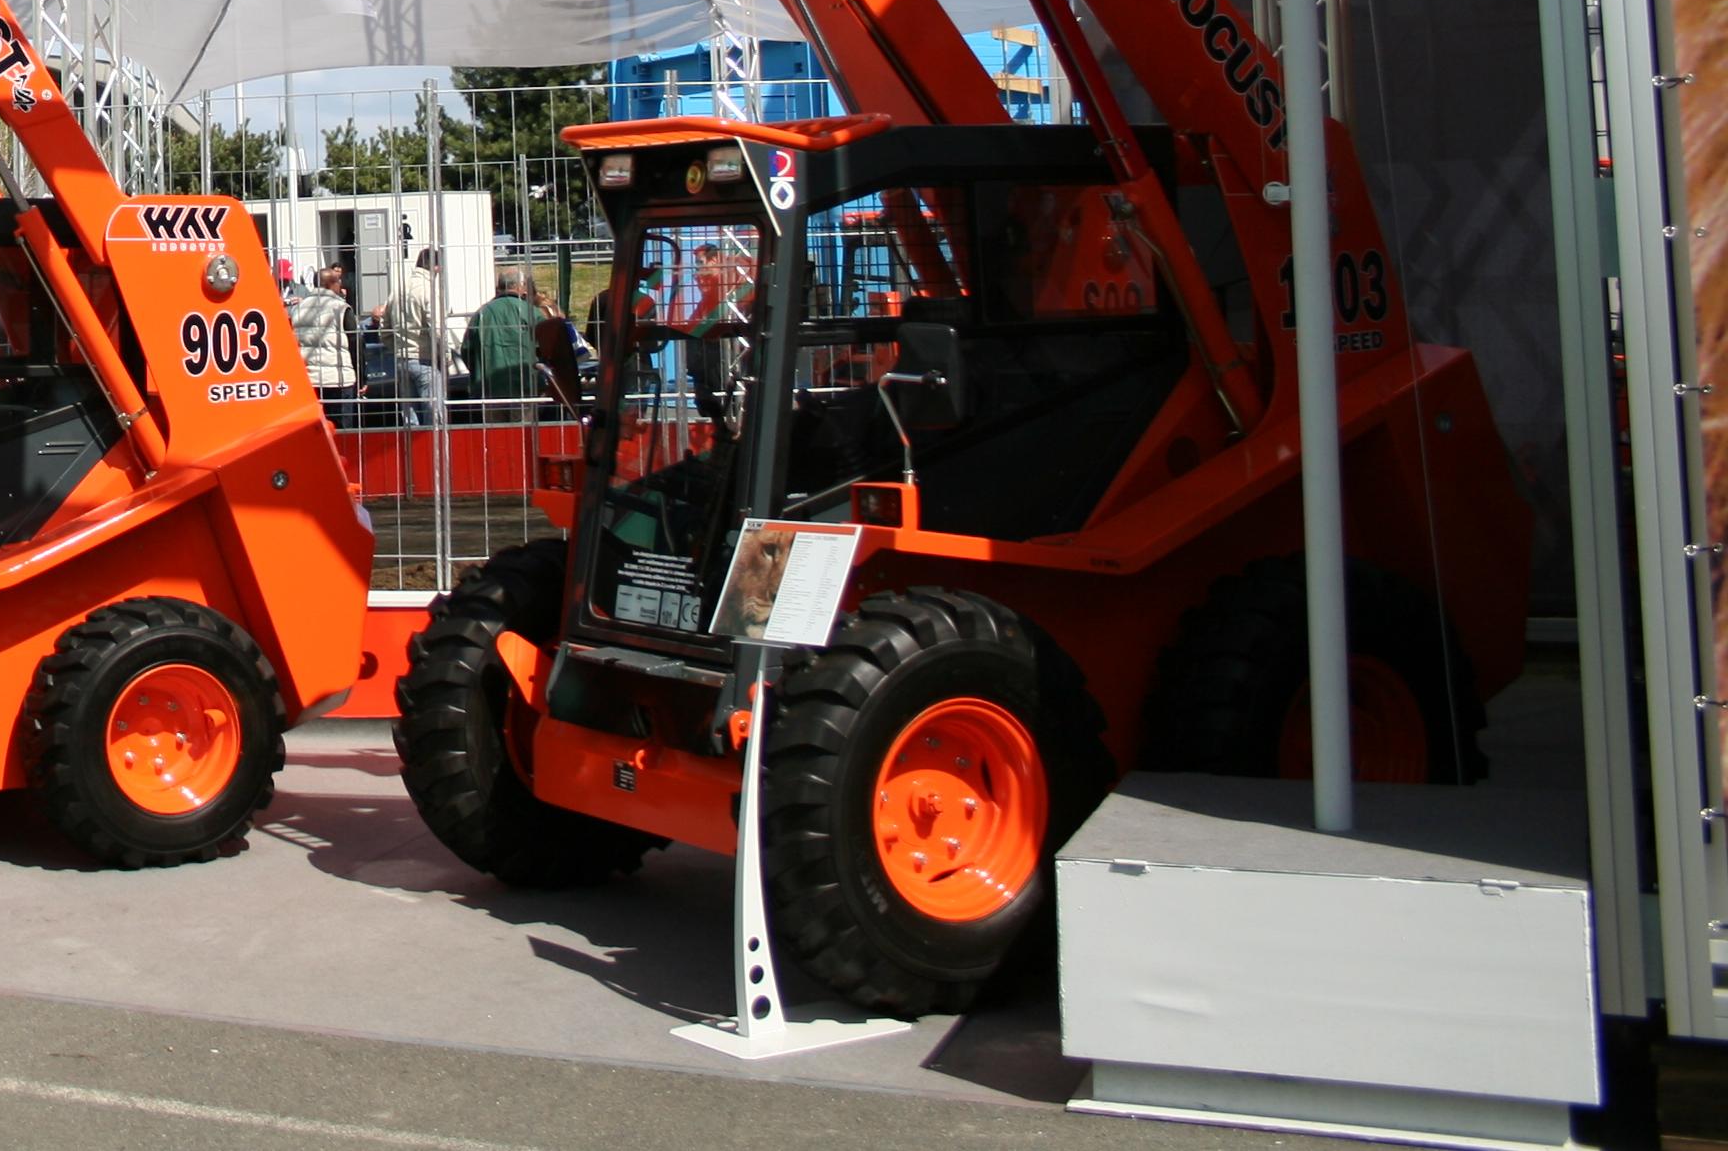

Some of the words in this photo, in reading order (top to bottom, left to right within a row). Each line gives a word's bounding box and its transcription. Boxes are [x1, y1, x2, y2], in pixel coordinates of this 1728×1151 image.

[138, 205, 229, 241] WAY
[1278, 249, 1388, 329] 103
[180, 309, 269, 377] 903
[208, 382, 271, 402] SPEED
